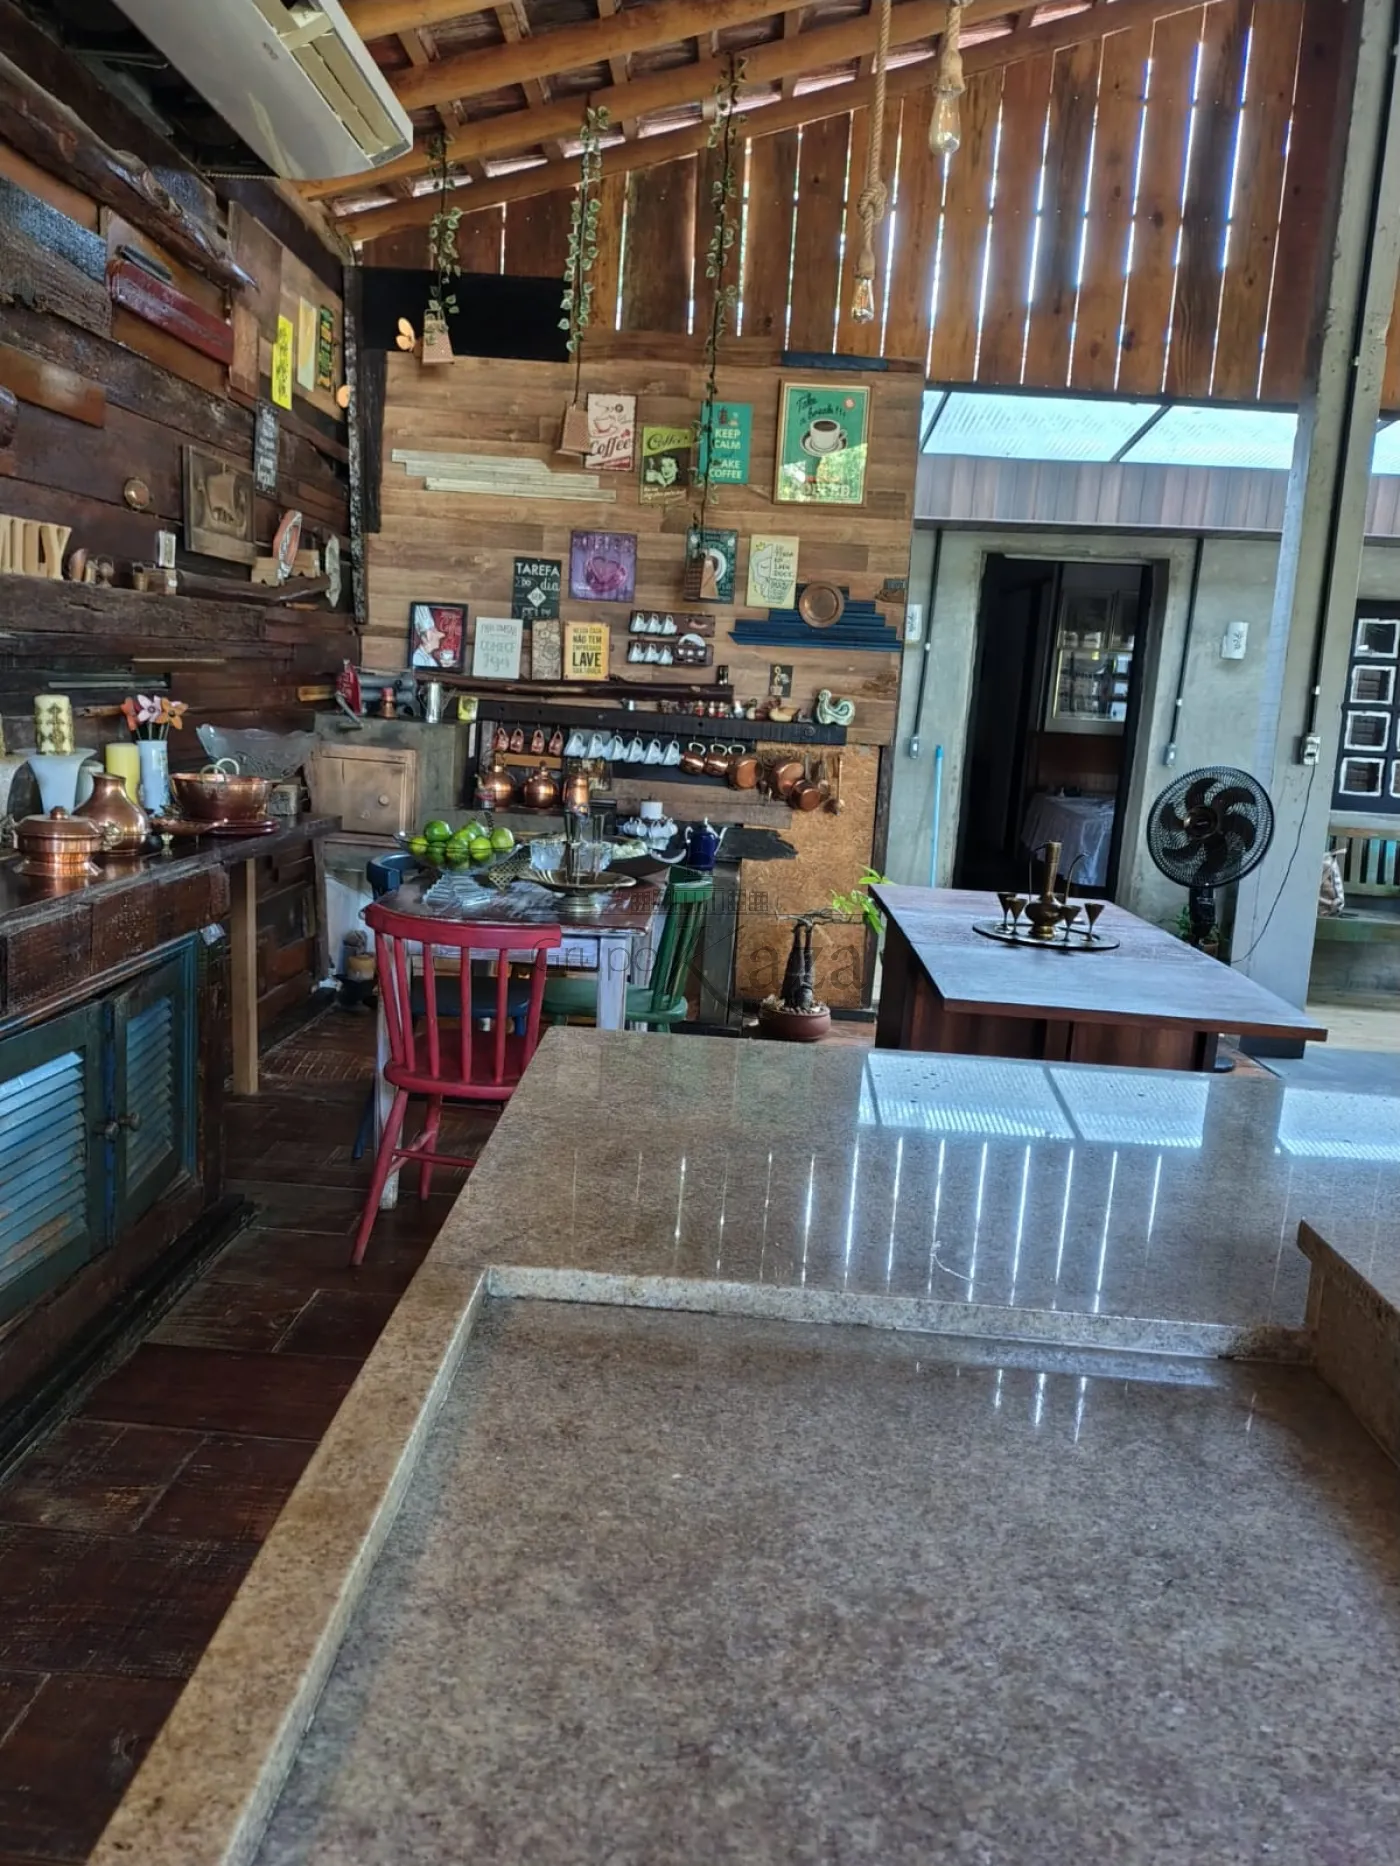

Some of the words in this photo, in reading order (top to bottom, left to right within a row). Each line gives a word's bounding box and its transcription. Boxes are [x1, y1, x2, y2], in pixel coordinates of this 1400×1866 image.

[715, 428, 742, 439] KEEP
[589, 436, 632, 458] Coffee
[714, 439, 742, 450] CALM
[708, 468, 744, 479] COFFEE
[516, 562, 560, 577] TAREFA
[540, 577, 560, 591] dia
[573, 634, 587, 644] NÃO
[588, 635, 602, 644] TEM
[572, 652, 602, 667] LAVE
